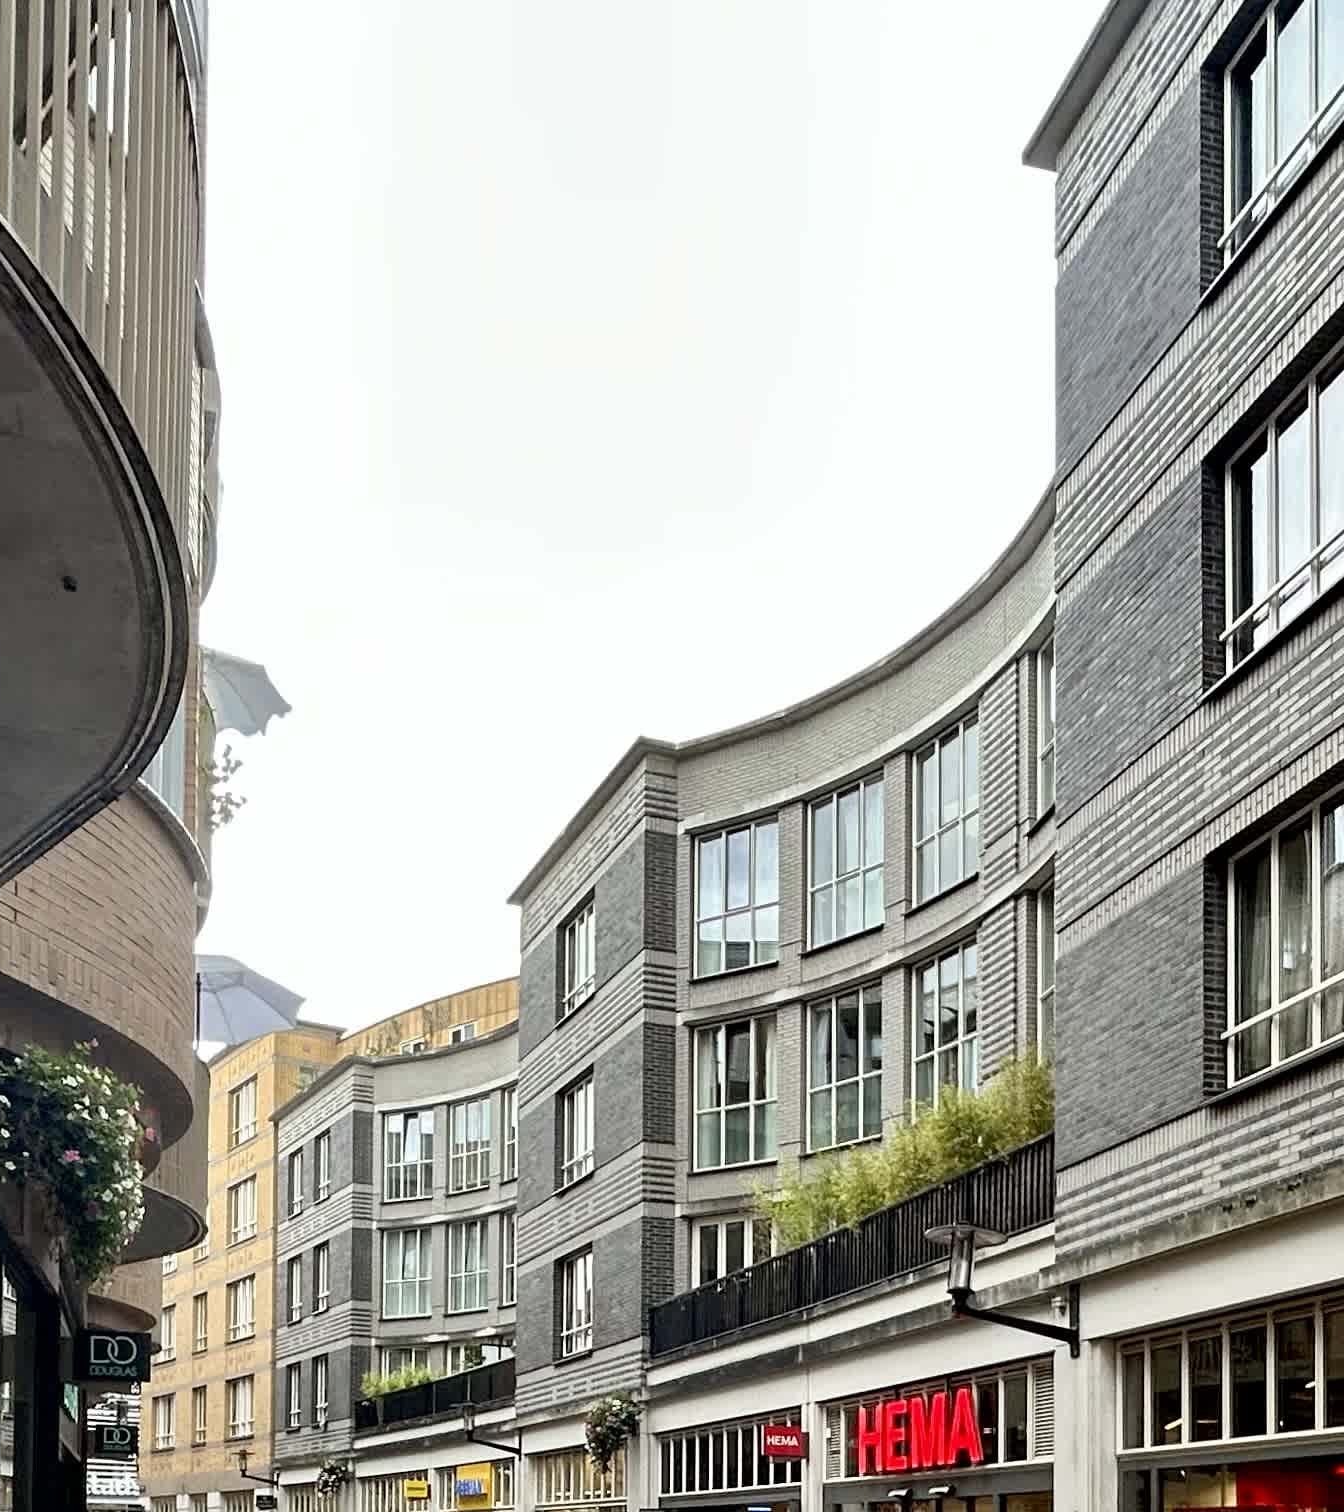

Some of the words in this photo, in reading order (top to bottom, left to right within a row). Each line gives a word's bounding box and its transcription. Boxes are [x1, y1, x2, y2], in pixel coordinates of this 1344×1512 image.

[89, 1365, 137, 1377] DOUGLAS
[858, 1386, 984, 1476] HEMA
[767, 1434, 799, 1446] HEMA
